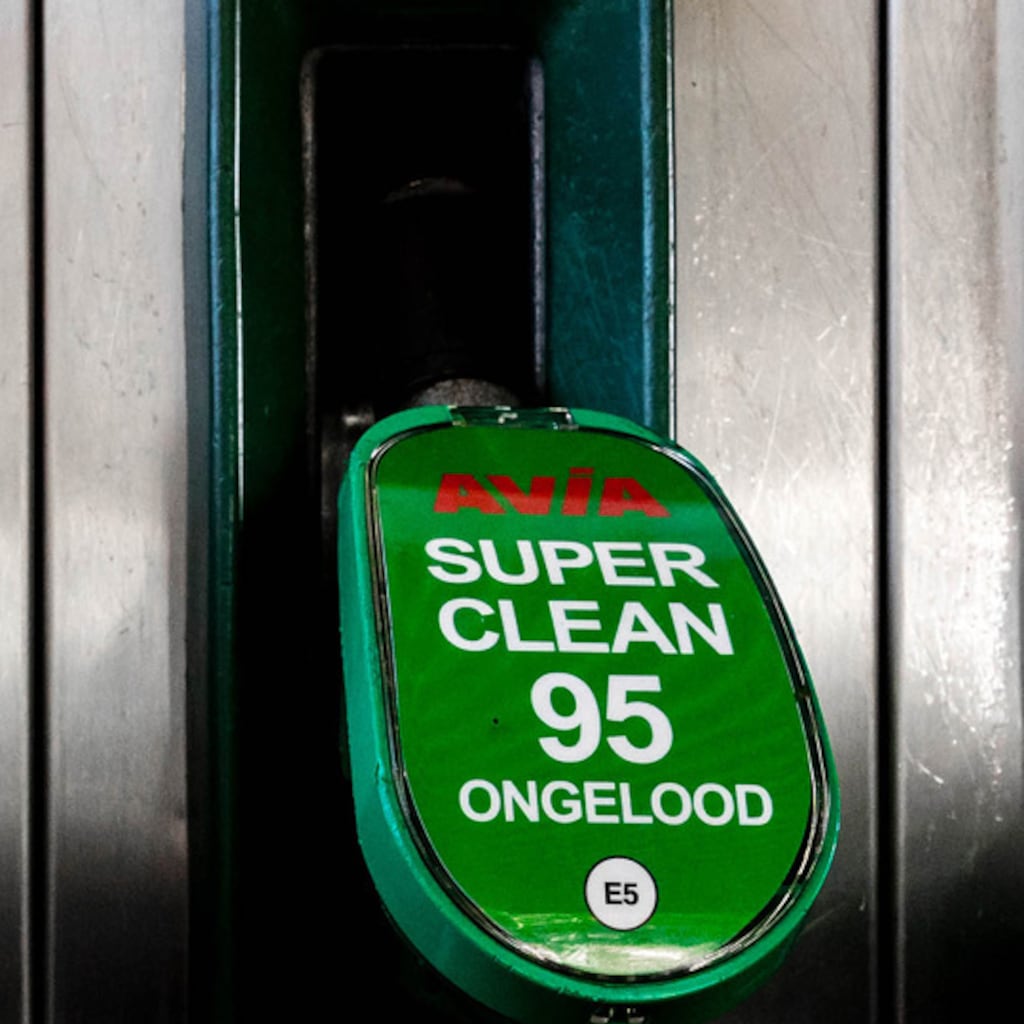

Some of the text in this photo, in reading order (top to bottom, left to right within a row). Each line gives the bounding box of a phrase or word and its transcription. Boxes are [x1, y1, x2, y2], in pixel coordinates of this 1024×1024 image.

[423, 537, 719, 588] SUPER
[438, 598, 734, 655] CLEAN
[529, 672, 674, 764] 95
[458, 779, 774, 826] ONGELOOD
[603, 883, 640, 906] E5
